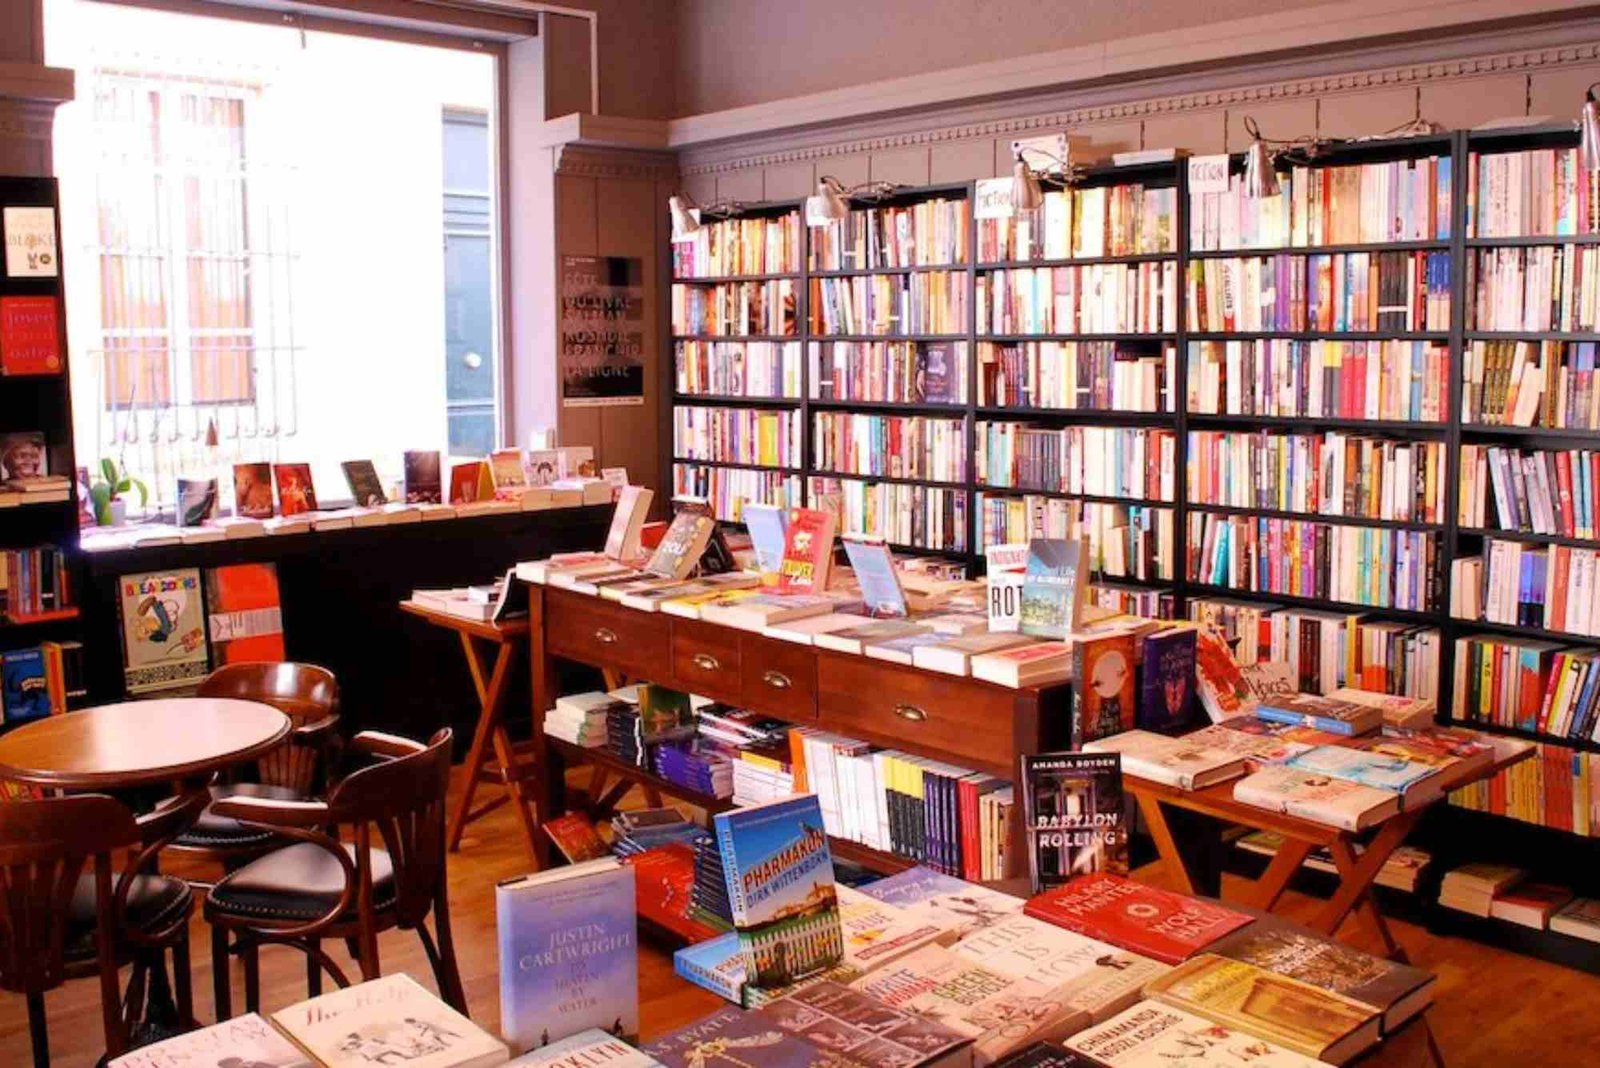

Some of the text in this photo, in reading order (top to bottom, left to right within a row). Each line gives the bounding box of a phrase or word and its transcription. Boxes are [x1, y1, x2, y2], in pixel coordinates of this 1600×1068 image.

[991, 585, 1024, 617] ROT
[1031, 758, 1116, 769] AMANDA BOYDEN
[1035, 813, 1118, 830] BABYLON
[1038, 831, 1117, 849] ROLLING
[742, 828, 824, 893] PHARMAKON
[746, 887, 771, 909] DIRK
[770, 851, 829, 896] WITTENBORN
[1053, 877, 1117, 909] HILARY
[1066, 883, 1144, 917] MANTEL
[549, 921, 607, 949] JUSTIN
[1149, 904, 1203, 934] WOLF
[1172, 911, 1229, 941] HALL
[518, 931, 632, 972] CARTWRIGHT
[963, 921, 1036, 955] THIS
[1012, 942, 1051, 961] IS
[931, 967, 997, 999] GREEN
[1076, 1007, 1162, 1053] CHIMAMANDA
